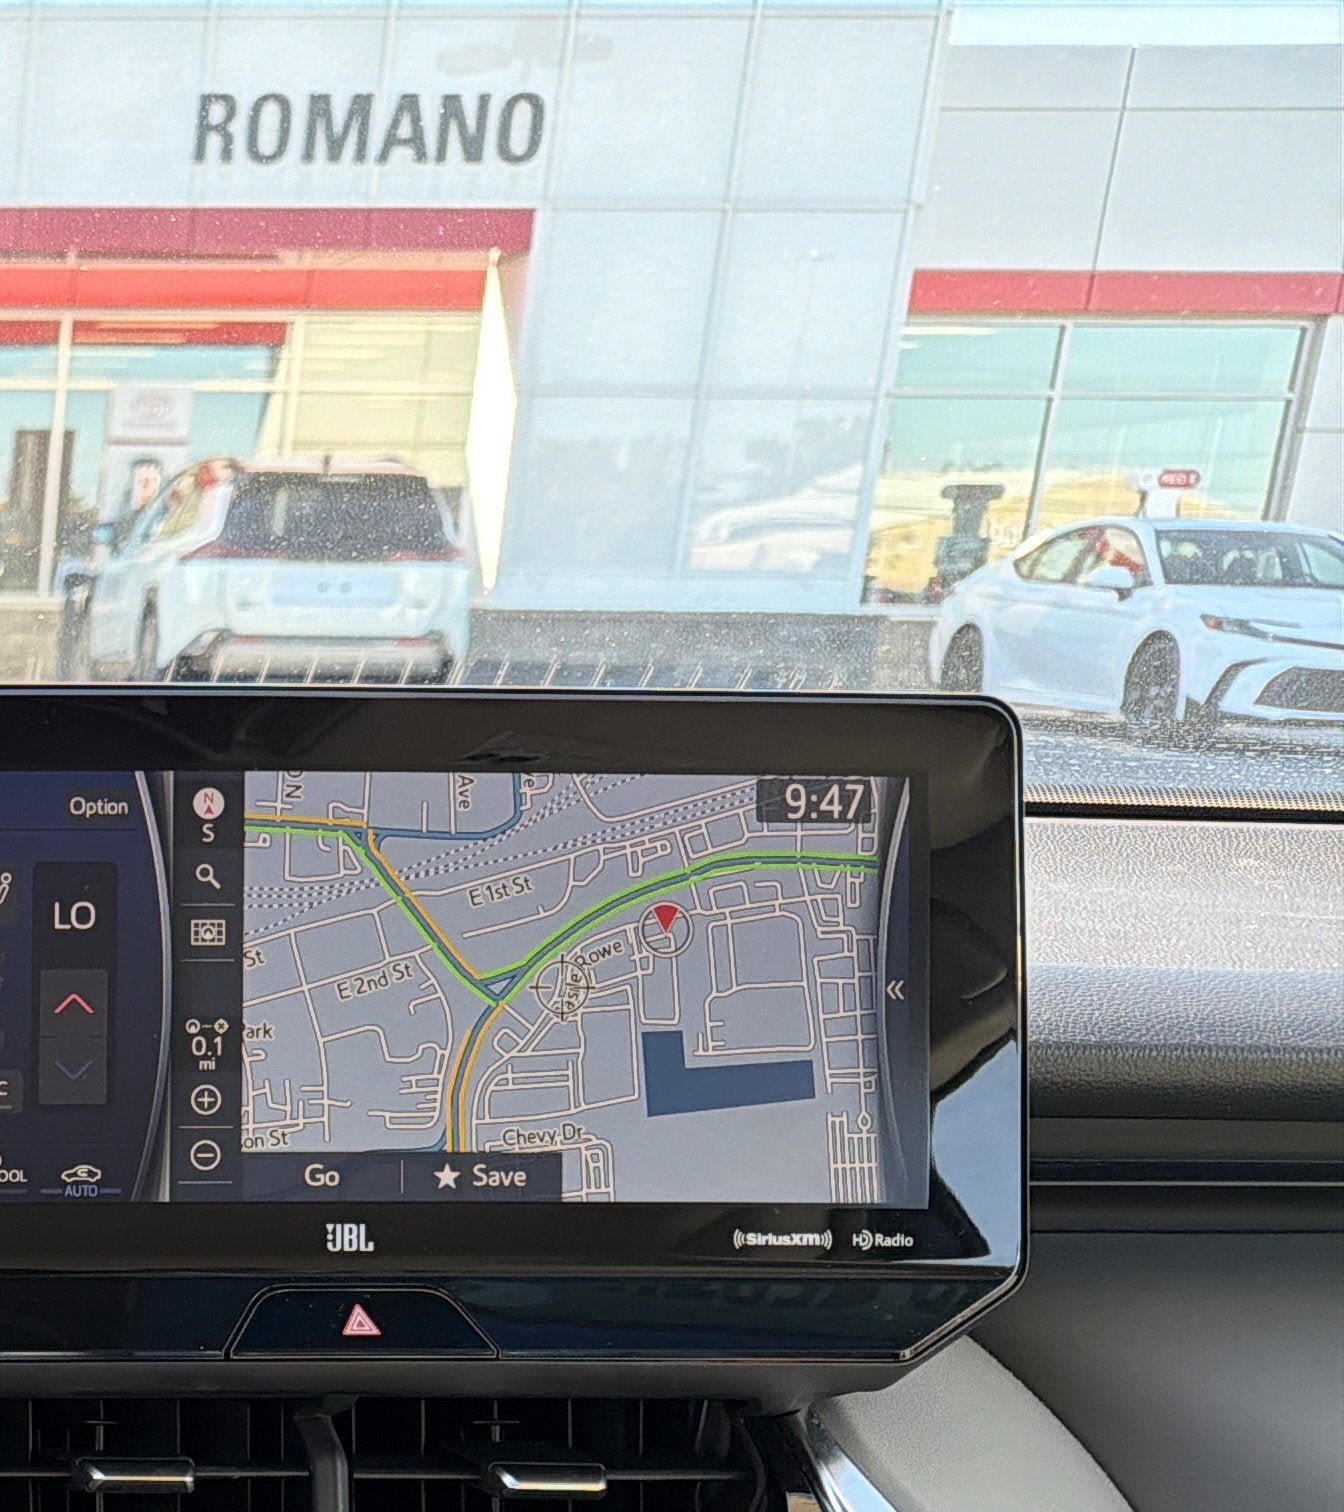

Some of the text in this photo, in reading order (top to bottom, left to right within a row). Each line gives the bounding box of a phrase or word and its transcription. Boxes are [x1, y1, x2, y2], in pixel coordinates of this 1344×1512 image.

[194, 92, 545, 165] ROMANO
[457, 773, 474, 811] Ave
[785, 783, 865, 819] 9:47
[69, 796, 129, 819] Option
[202, 823, 215, 843] S
[469, 875, 533, 907] E 1st St
[53, 901, 97, 931] LO
[243, 950, 264, 967] St
[573, 940, 625, 970] Rowe
[337, 961, 413, 1000] E 2nd St
[243, 1022, 273, 1039] ark
[190, 1035, 224, 1058] 0.1
[199, 1058, 217, 1071] mi
[269, 1129, 289, 1147] St
[502, 1122, 584, 1147] Chevy Dr
[304, 1163, 340, 1187] Go
[473, 1163, 527, 1187] Save
[65, 1184, 99, 1198] AUTO
[326, 1223, 374, 1252] JBL
[875, 1233, 914, 1247] Radio
